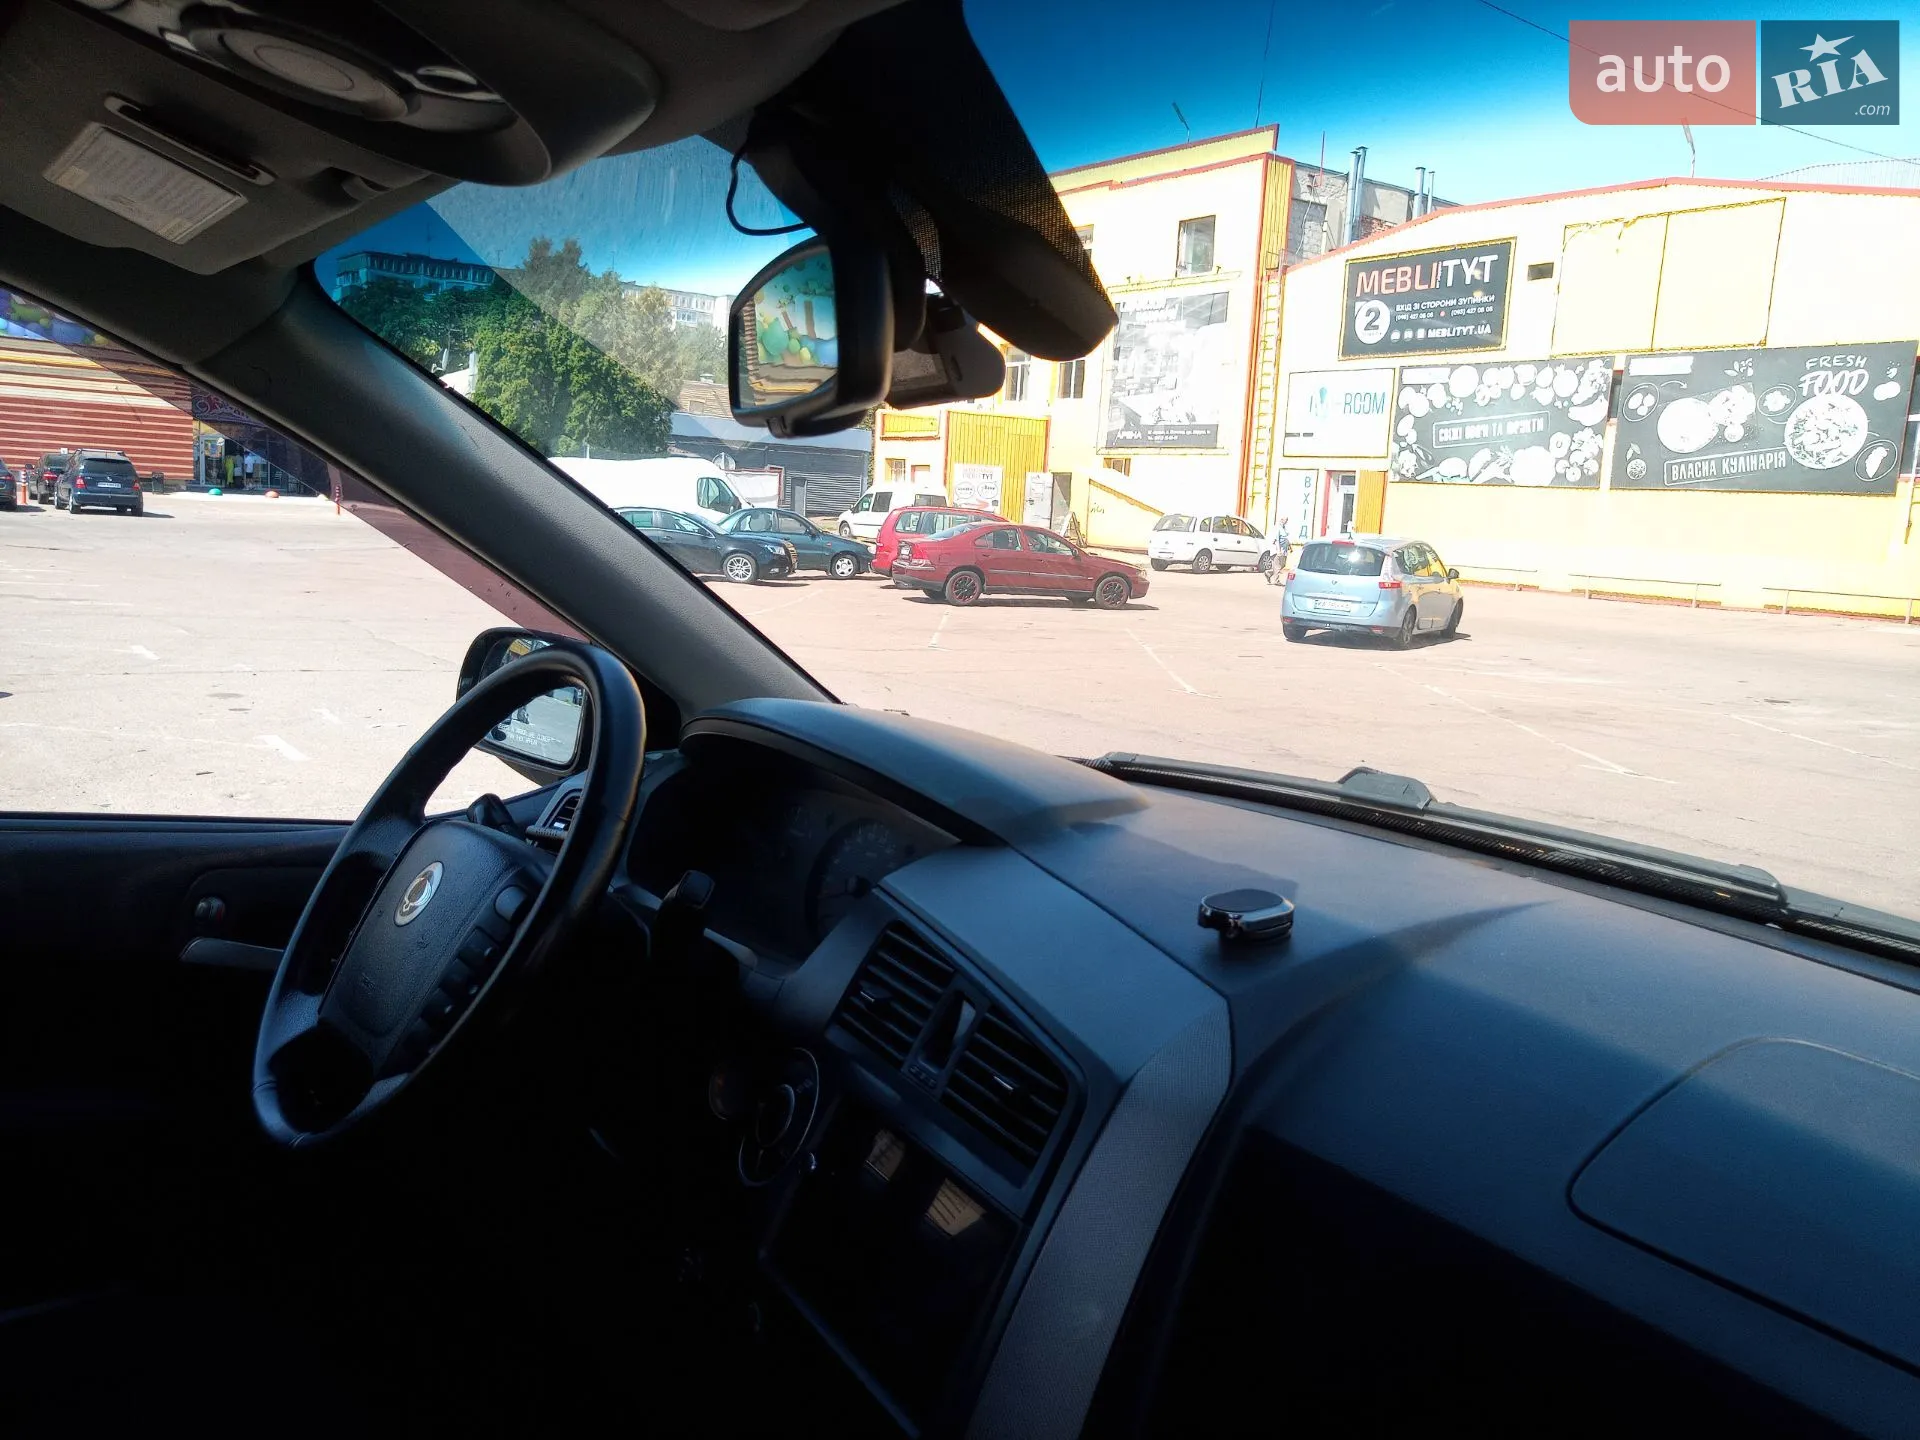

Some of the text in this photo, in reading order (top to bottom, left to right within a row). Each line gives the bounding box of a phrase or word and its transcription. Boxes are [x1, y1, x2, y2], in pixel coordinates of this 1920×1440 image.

[1421, 298, 1457, 309] СТОРОНИ
[1458, 294, 1495, 306] ЗУПИНКИ
[1364, 306, 1381, 331] 2
[1427, 323, 1492, 338] MEBLITYT.UA
[1805, 354, 1868, 370] FRESH
[1798, 368, 1869, 397] FOOD
[1671, 450, 1786, 481] ВЛАСНА КУЛІНАРІЯ
